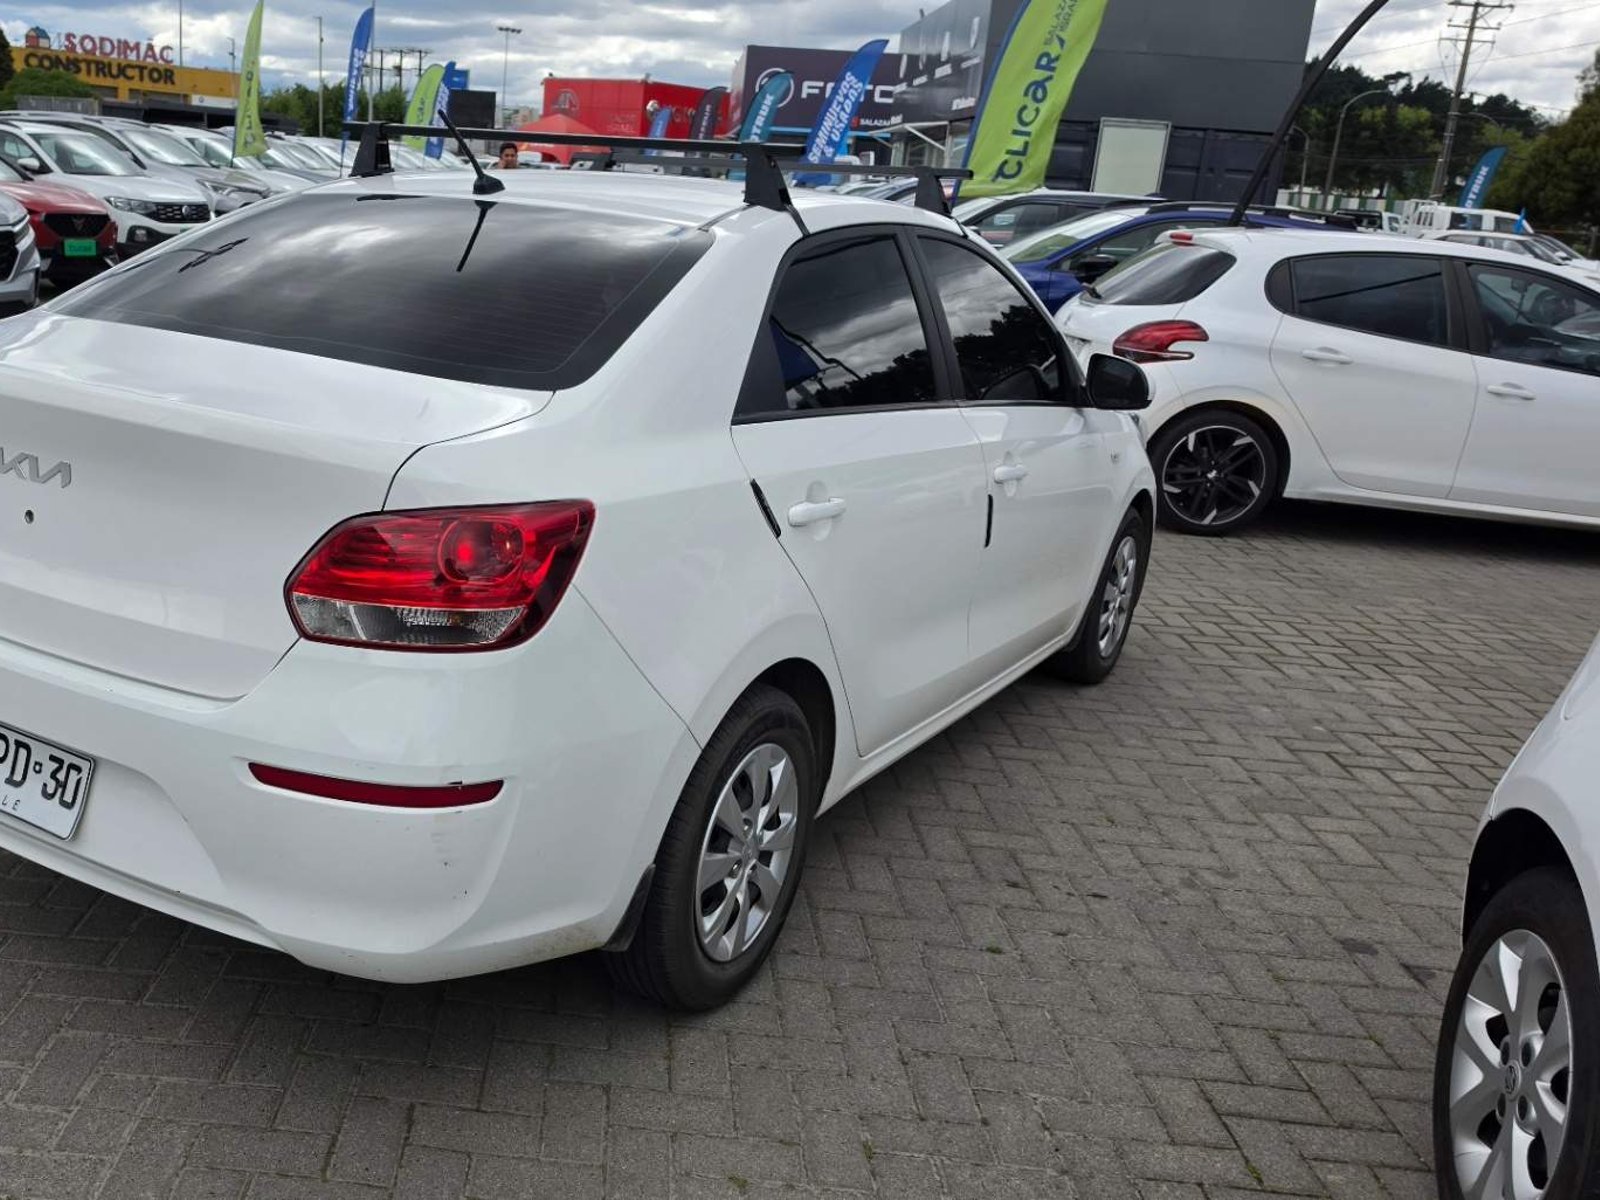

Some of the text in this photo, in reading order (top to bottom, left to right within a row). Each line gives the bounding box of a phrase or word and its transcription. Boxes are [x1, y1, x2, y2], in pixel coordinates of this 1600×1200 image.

[24, 52, 176, 85] CONSTRUCTOR
[63, 32, 174, 65] SODIMAC
[750, 93, 774, 142] OTRUK
[807, 71, 859, 164] SEMINUEVOS
[823, 81, 864, 158] & USADOS
[992, 51, 1061, 182] CLICAR
